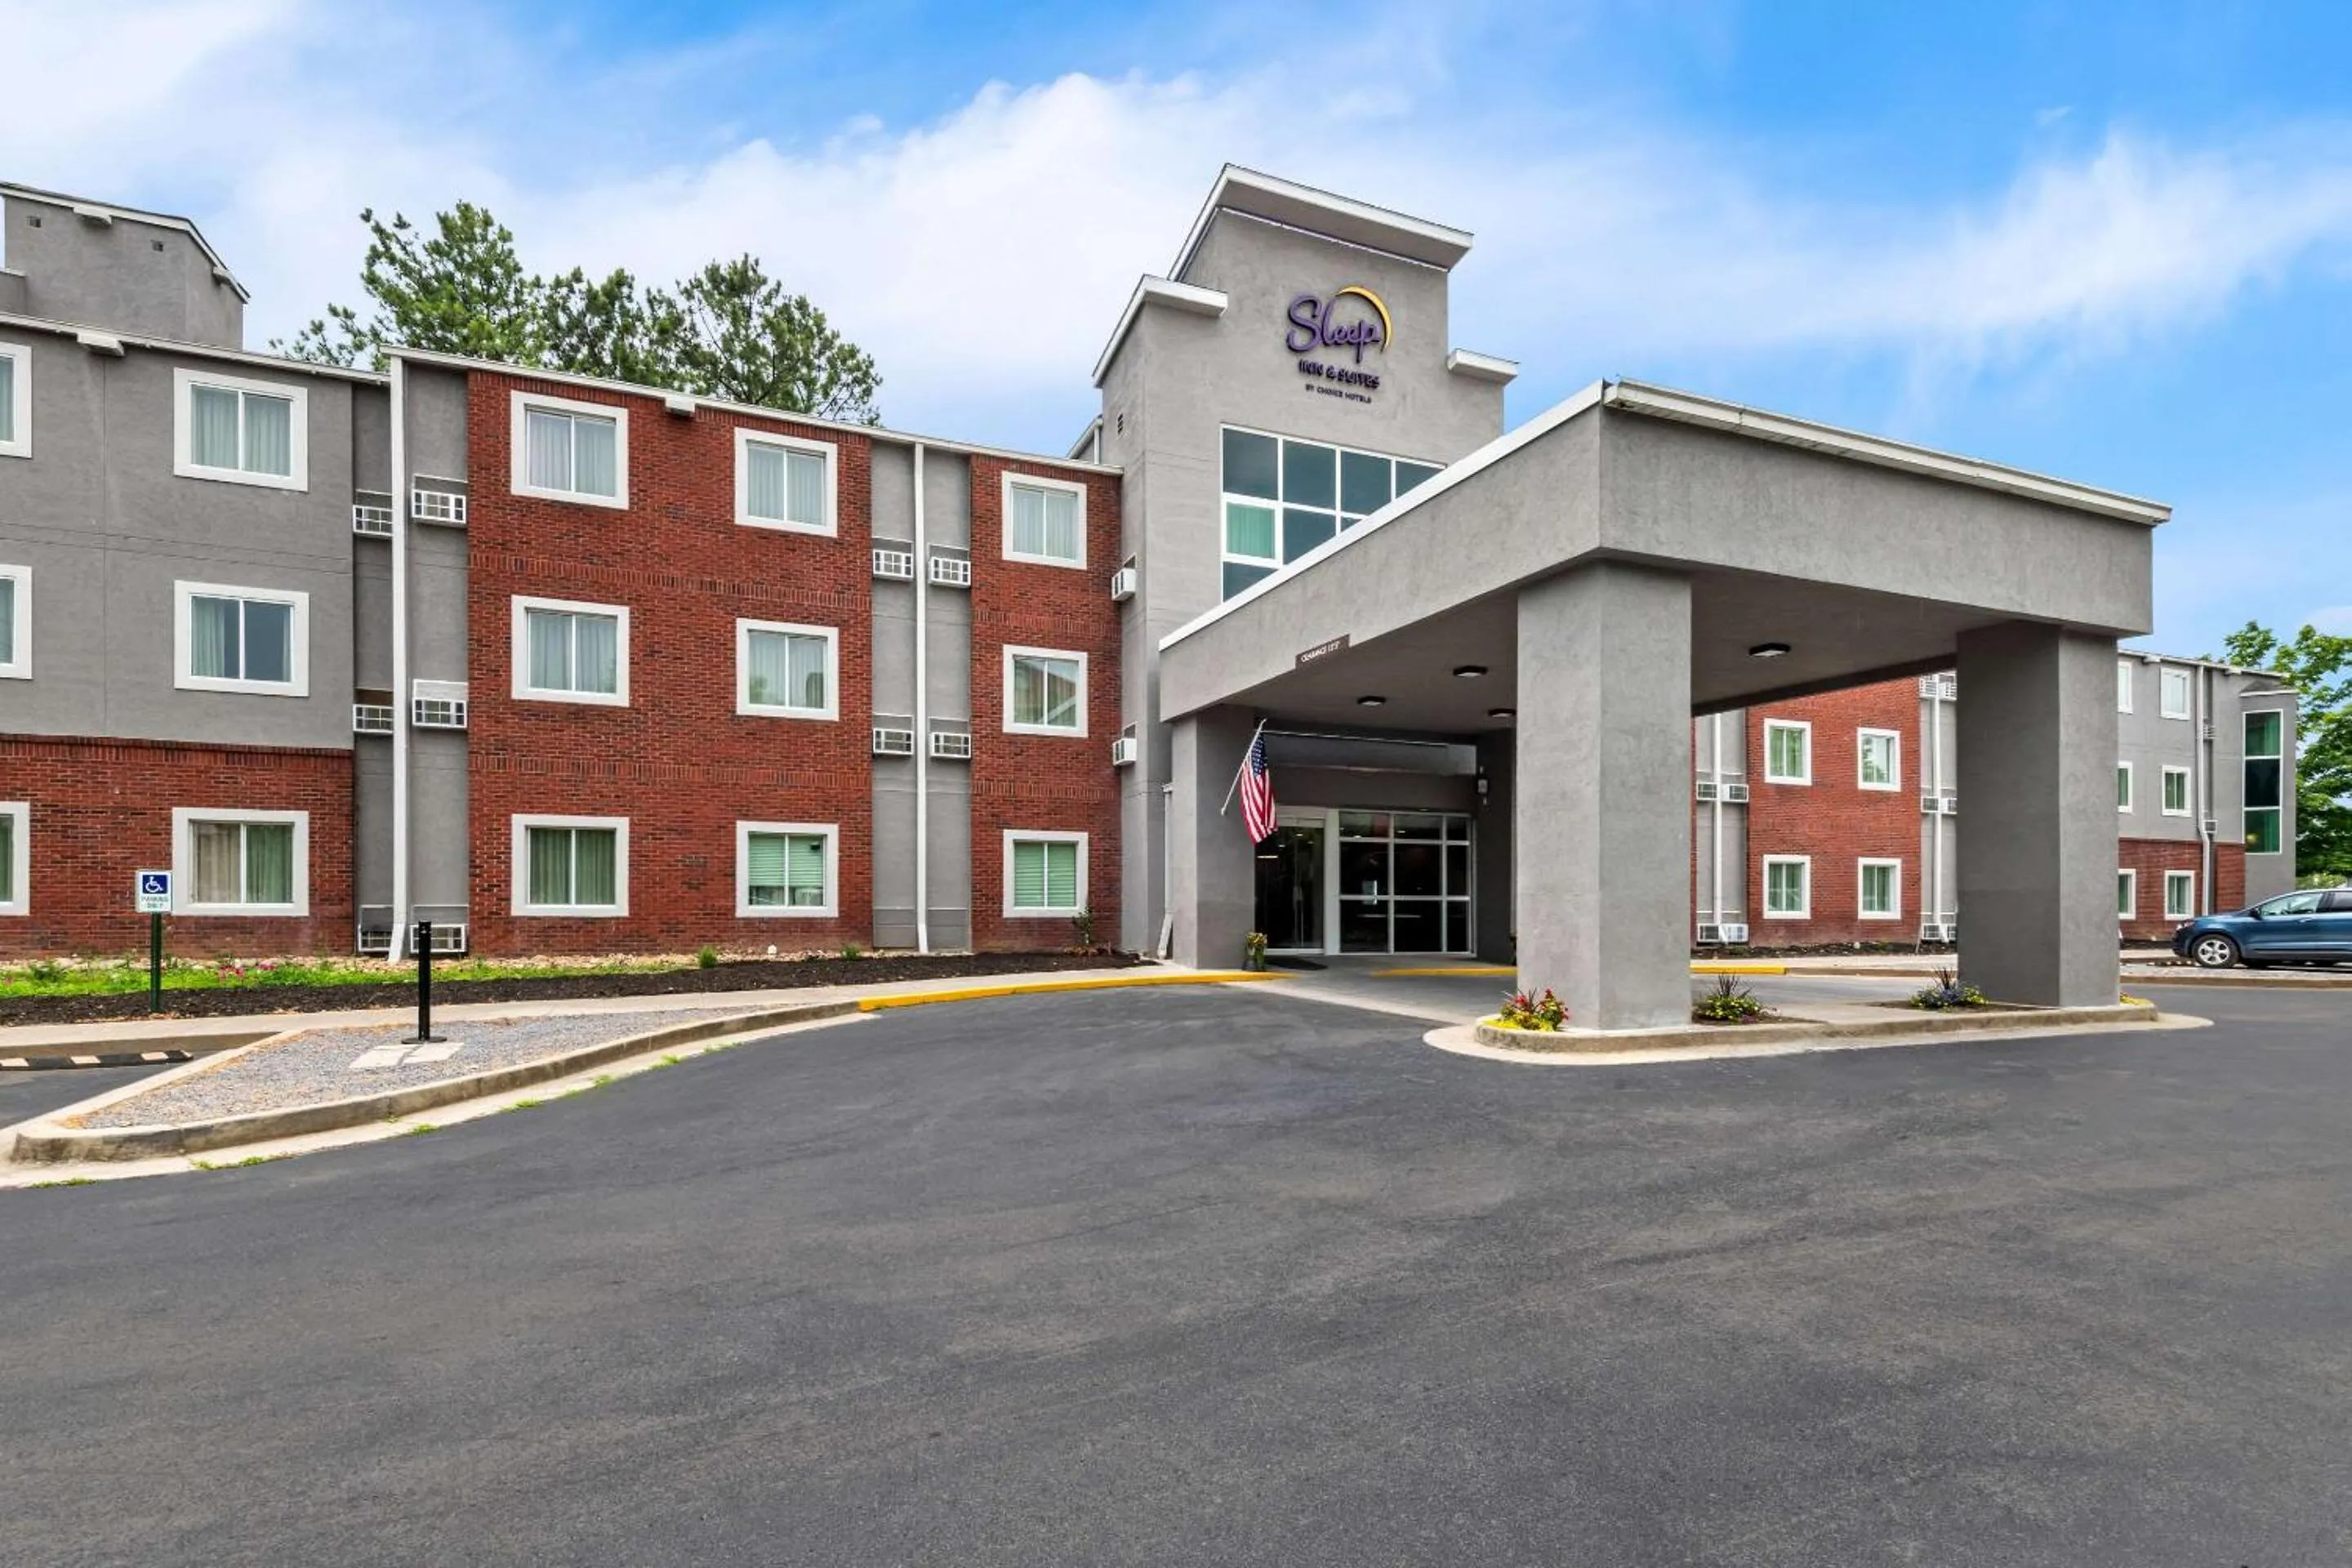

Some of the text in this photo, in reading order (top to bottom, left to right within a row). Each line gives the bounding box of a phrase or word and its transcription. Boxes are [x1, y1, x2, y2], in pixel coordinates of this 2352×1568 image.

[1286, 295, 1382, 364] Sleep
[1298, 359, 1380, 390] INN & SUITES
[1316, 386, 1343, 398] CHOICE
[1345, 392, 1372, 403] HOTELS
